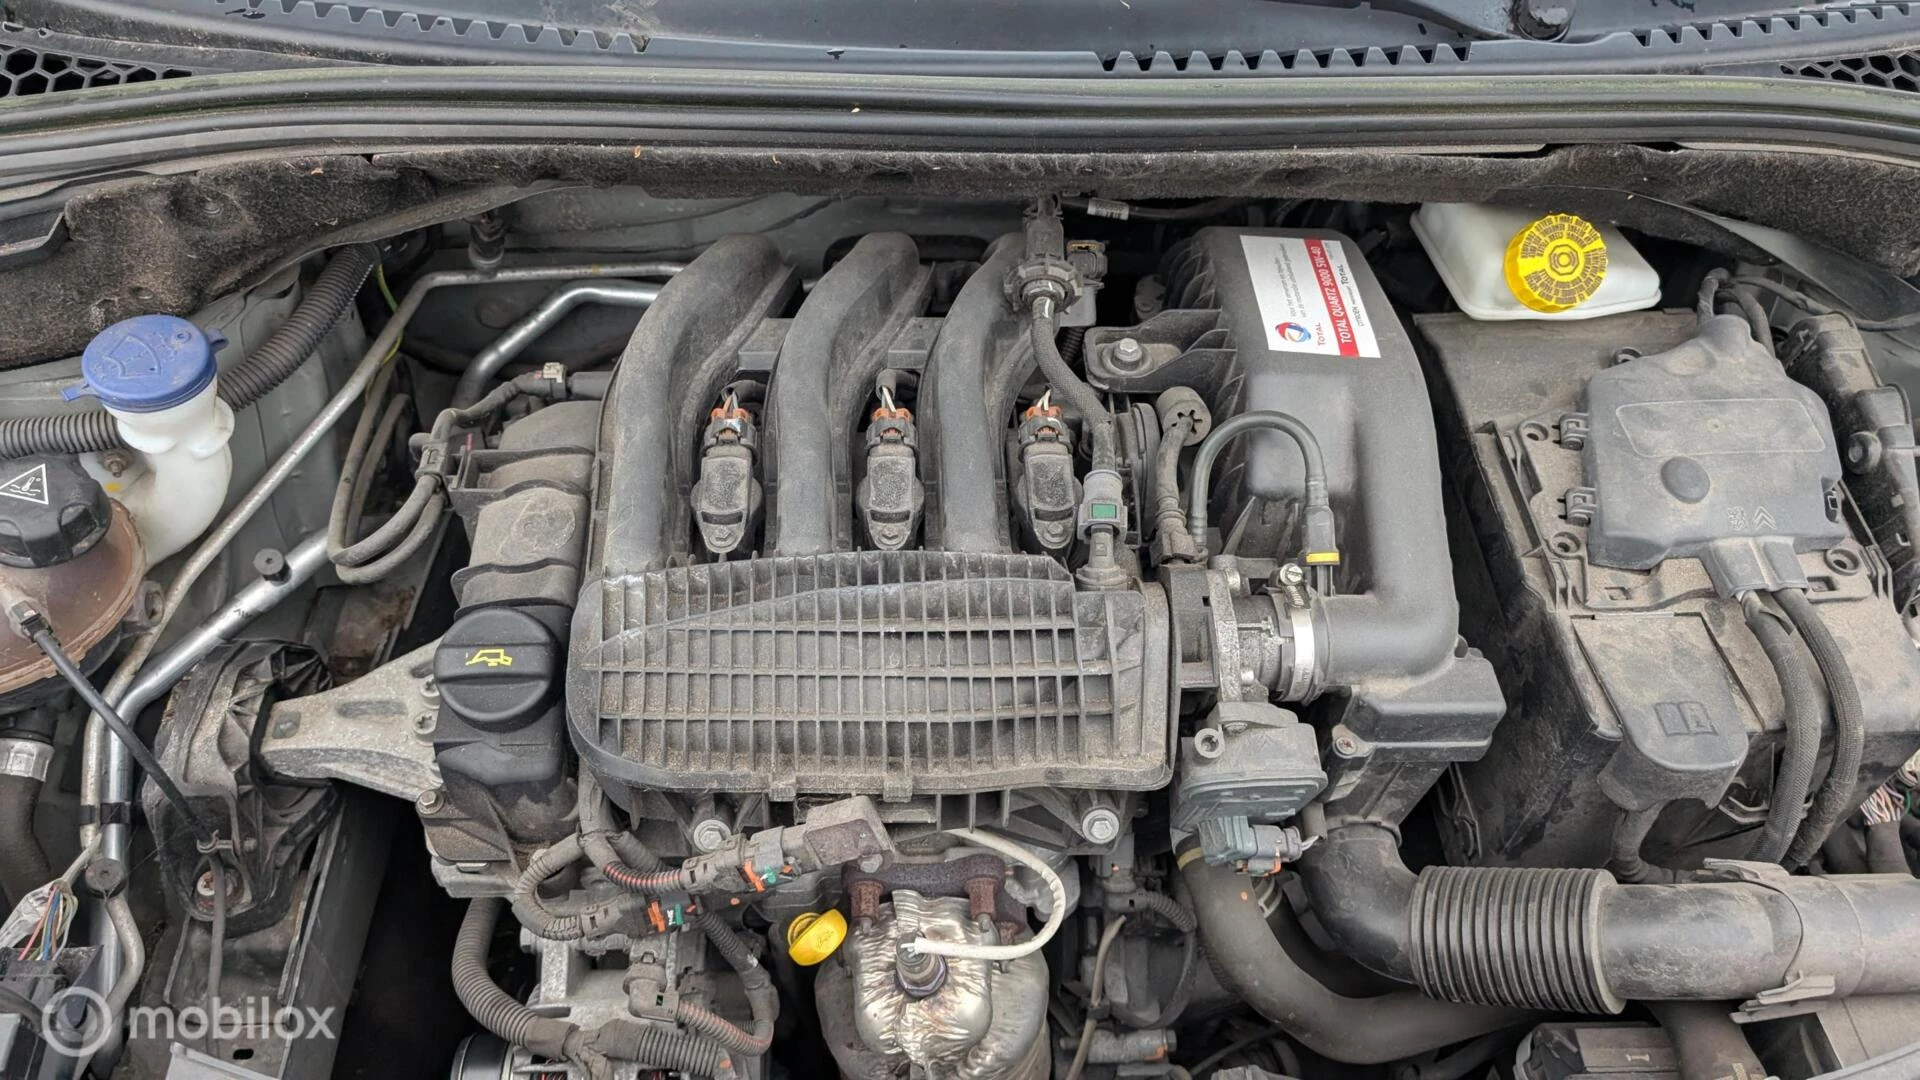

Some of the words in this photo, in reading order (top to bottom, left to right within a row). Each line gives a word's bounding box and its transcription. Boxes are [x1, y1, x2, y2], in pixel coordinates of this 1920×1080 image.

[1311, 246, 1327, 268] 5W-40
[1319, 269, 1334, 287] 9000
[1337, 264, 1349, 285] TOTAL
[1325, 288, 1345, 317] QUARTZ
[1315, 322, 1326, 346] TOTAL
[1336, 320, 1352, 344] TOTAL
